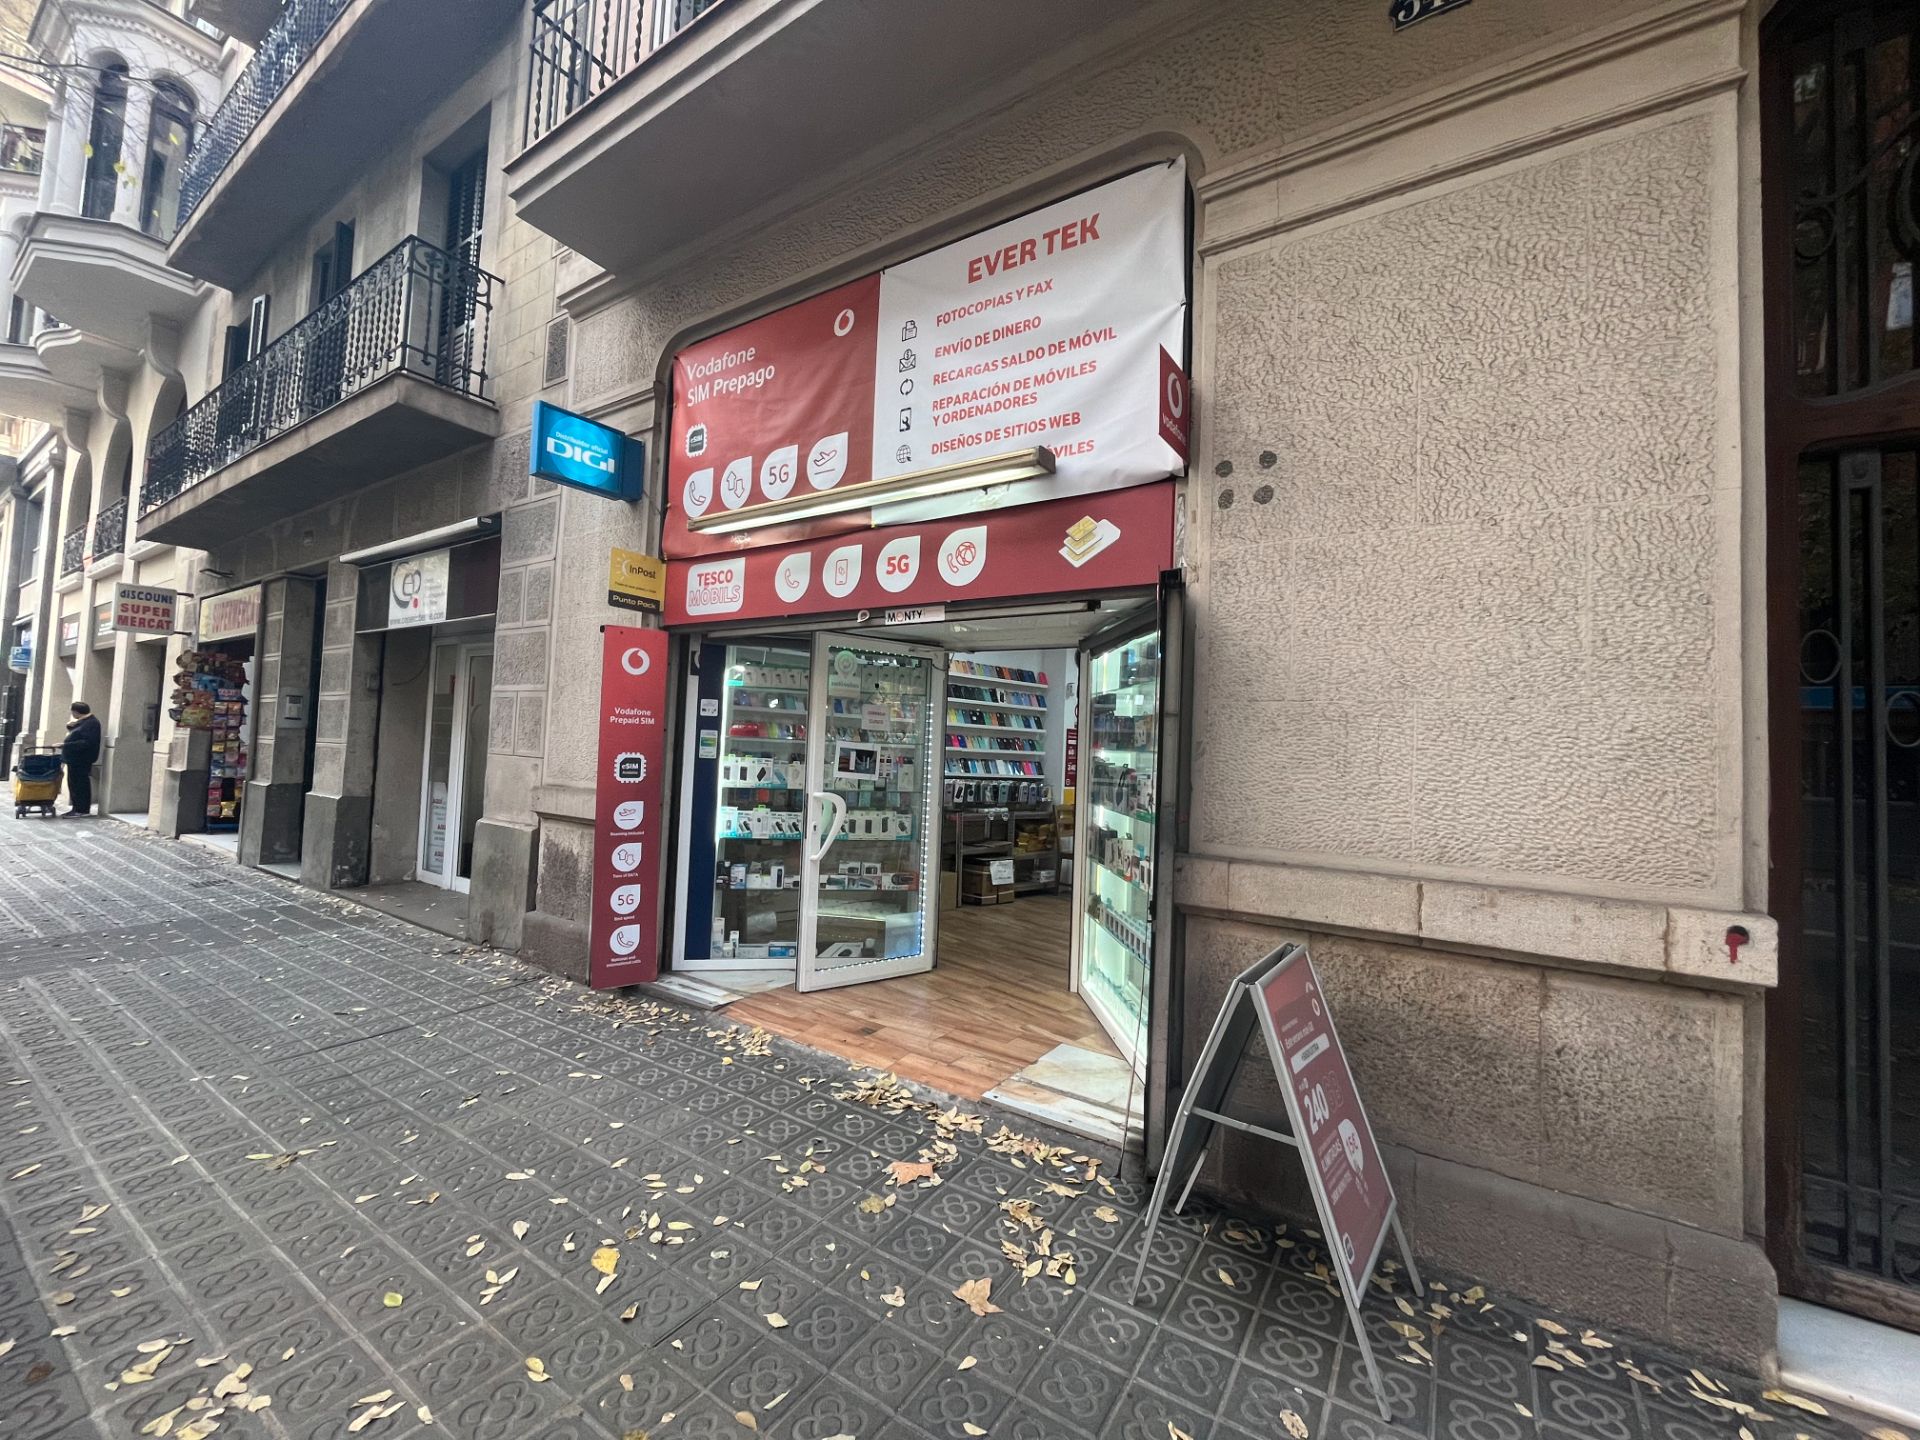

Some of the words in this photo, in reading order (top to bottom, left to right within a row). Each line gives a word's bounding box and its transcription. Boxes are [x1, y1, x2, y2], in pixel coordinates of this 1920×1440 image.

[967, 238, 1037, 284] EVER
[1042, 212, 1101, 255] TEK
[935, 292, 1013, 327] FOTOCOPIAS
[1015, 287, 1025, 302] Y
[1027, 278, 1053, 298] FAX
[934, 339, 972, 358] ENVÍO
[974, 331, 991, 346] DE
[993, 316, 1042, 340] DINERO
[687, 346, 756, 382] Vodafone
[933, 360, 999, 386] RECARGAS
[1001, 347, 1045, 369] SALDO
[1048, 341, 1067, 357] DE
[1068, 327, 1117, 351] MÓVIL
[687, 385, 709, 407] SIM
[713, 364, 775, 397] Prepago
[932, 381, 1009, 412] REPARACIÓN
[1013, 376, 1030, 393] DE
[1033, 360, 1097, 387] MÓVILES
[933, 415, 941, 428] Y
[942, 392, 1038, 424] ORDENADORES
[931, 433, 983, 456] DISEÑOS
[984, 427, 1001, 443] DE
[1003, 418, 1047, 439] SITIOS
[1049, 411, 1081, 429] WEB
[546, 436, 616, 474] DIGI
[768, 462, 790, 486] 5G
[629, 564, 657, 580] InPost
[697, 569, 734, 586] TESCO
[886, 554, 910, 575] 5G
[120, 602, 171, 618] SUPER
[612, 594, 637, 606] Punto
[637, 599, 657, 610] Pack
[886, 610, 923, 623] MONTY
[117, 614, 173, 631] MERCAT
[610, 716, 639, 725] Prepaid
[640, 716, 654, 725] SIM
[615, 707, 651, 716] Vodafone
[617, 894, 634, 906] 5G
[1303, 1082, 1330, 1136] 240
